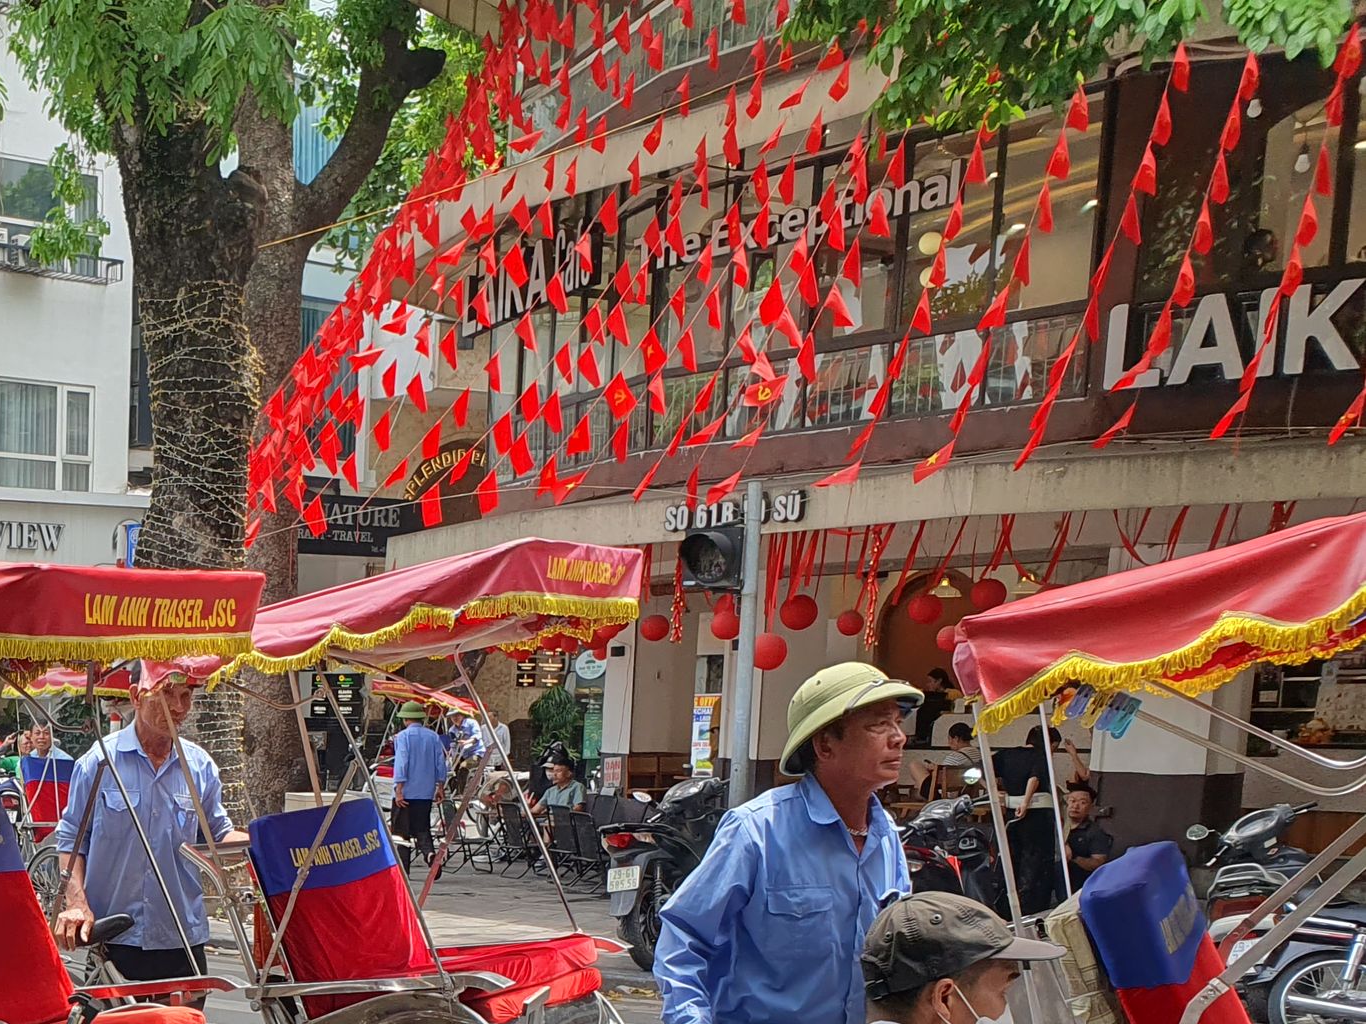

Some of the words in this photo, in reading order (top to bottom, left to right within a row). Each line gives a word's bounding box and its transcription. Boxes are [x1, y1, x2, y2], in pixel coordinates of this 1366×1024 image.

[1103, 278, 1366, 391] LAIK
[301, 501, 401, 528] ATURE
[84, 593, 119, 626] LAM
[117, 596, 152, 628] ANH
